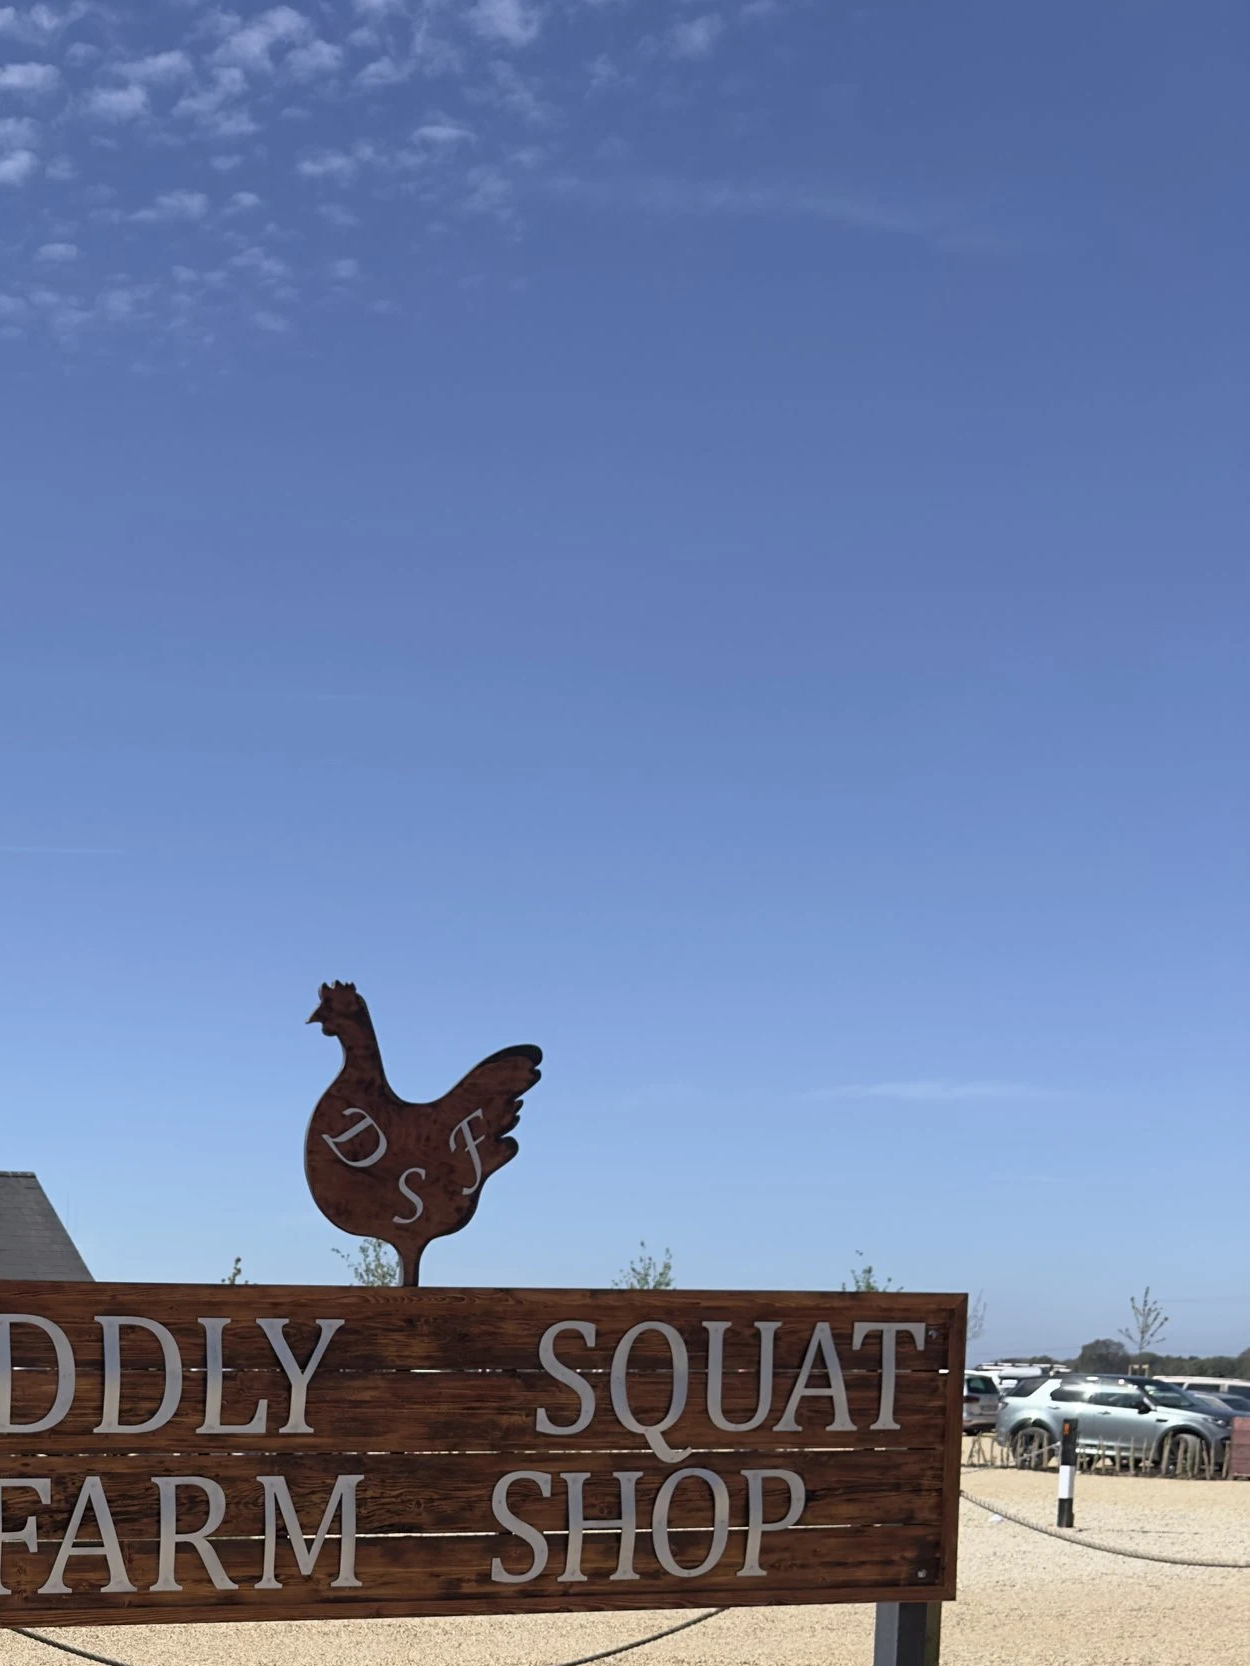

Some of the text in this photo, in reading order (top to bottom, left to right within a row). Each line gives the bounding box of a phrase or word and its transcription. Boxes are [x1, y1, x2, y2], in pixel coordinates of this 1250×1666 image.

[322, 1107, 486, 1224] D S F
[535, 1320, 927, 1463] SQUAT
[490, 1467, 806, 1584] SHOP
